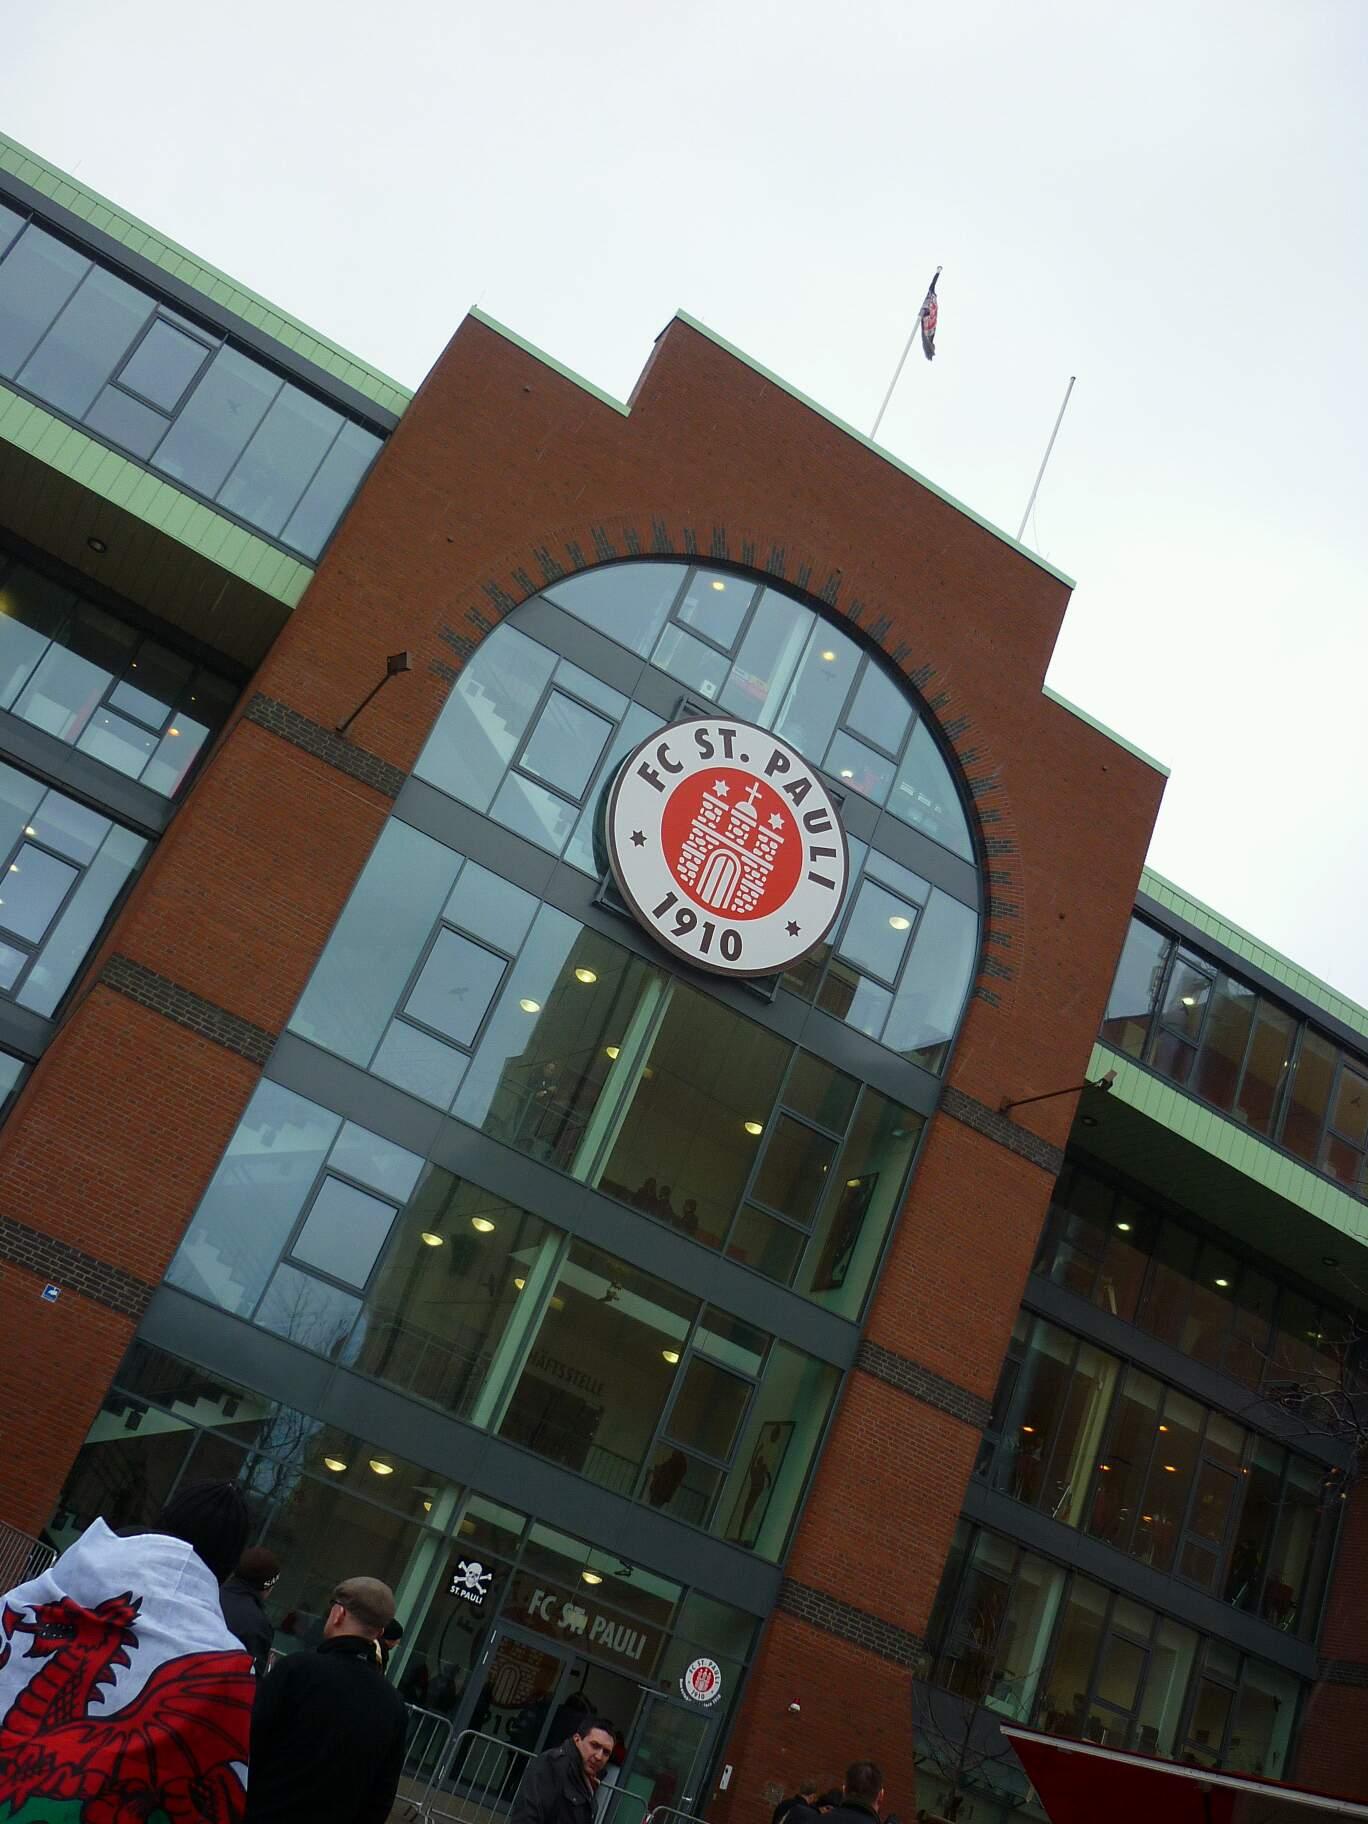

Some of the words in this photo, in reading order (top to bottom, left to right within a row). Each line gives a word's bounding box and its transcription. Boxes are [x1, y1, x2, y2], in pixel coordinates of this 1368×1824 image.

[636, 742, 684, 793] FC
[694, 728, 750, 763] ST.
[764, 748, 837, 890] PAULI
[652, 891, 742, 961] 1910
[460, 1589, 484, 1605] PAULI
[528, 1588, 557, 1622] FC
[589, 1615, 647, 1660] PAULI
